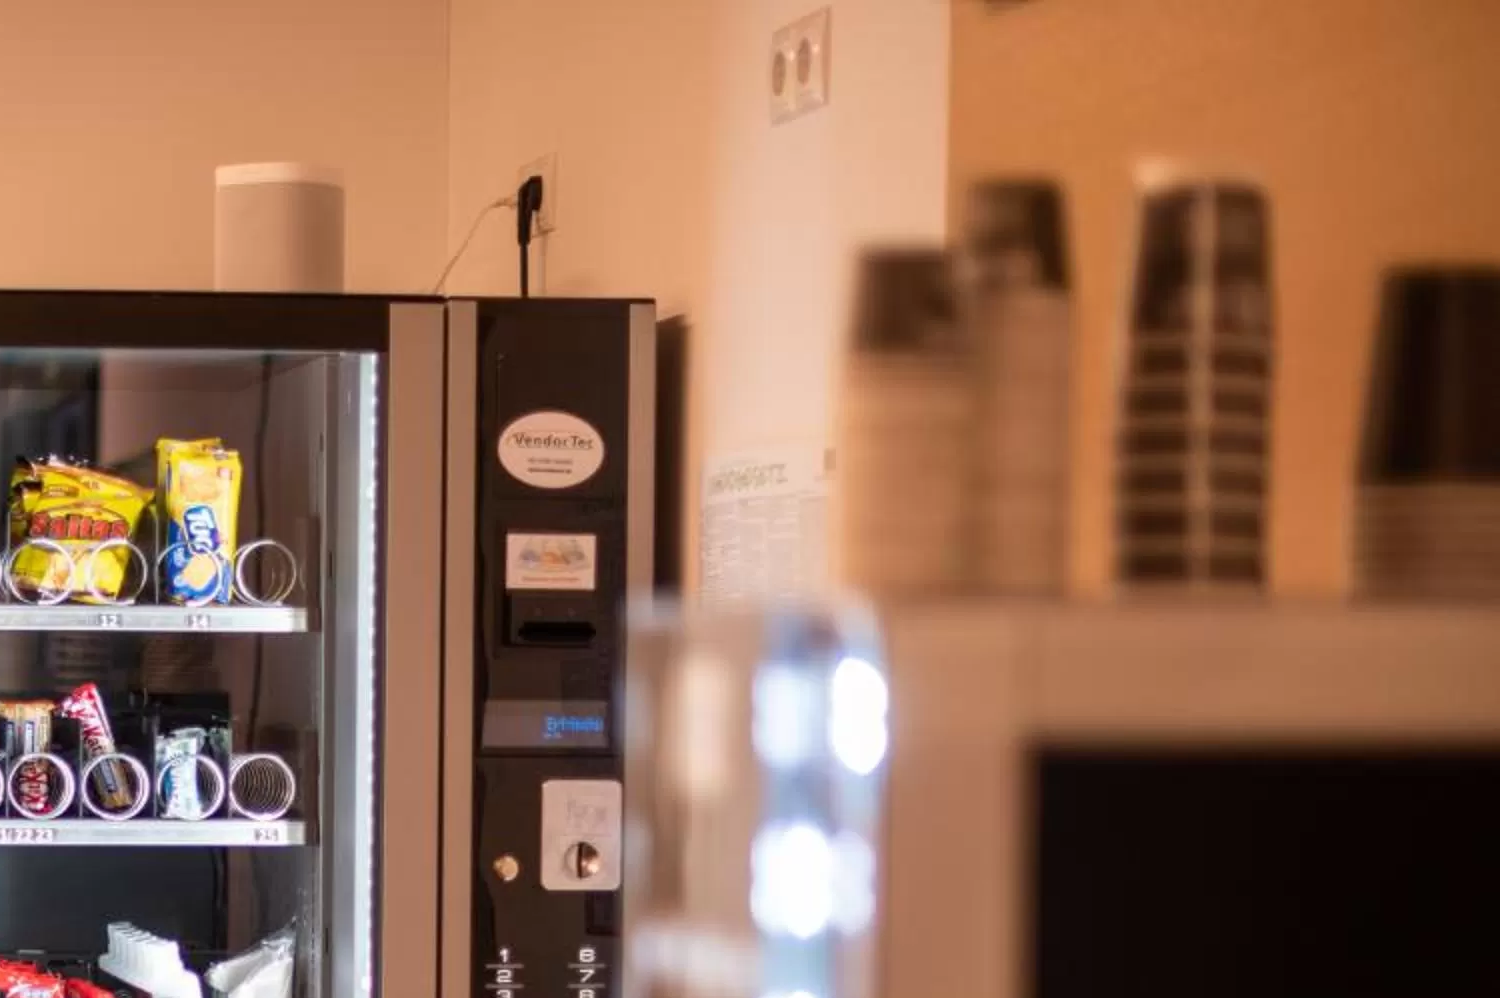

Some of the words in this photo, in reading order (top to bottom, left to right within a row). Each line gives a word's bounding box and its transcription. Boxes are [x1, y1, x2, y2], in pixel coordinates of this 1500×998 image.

[500, 948, 509, 963] 1
[496, 969, 512, 983] 2
[579, 969, 595, 982] 7
